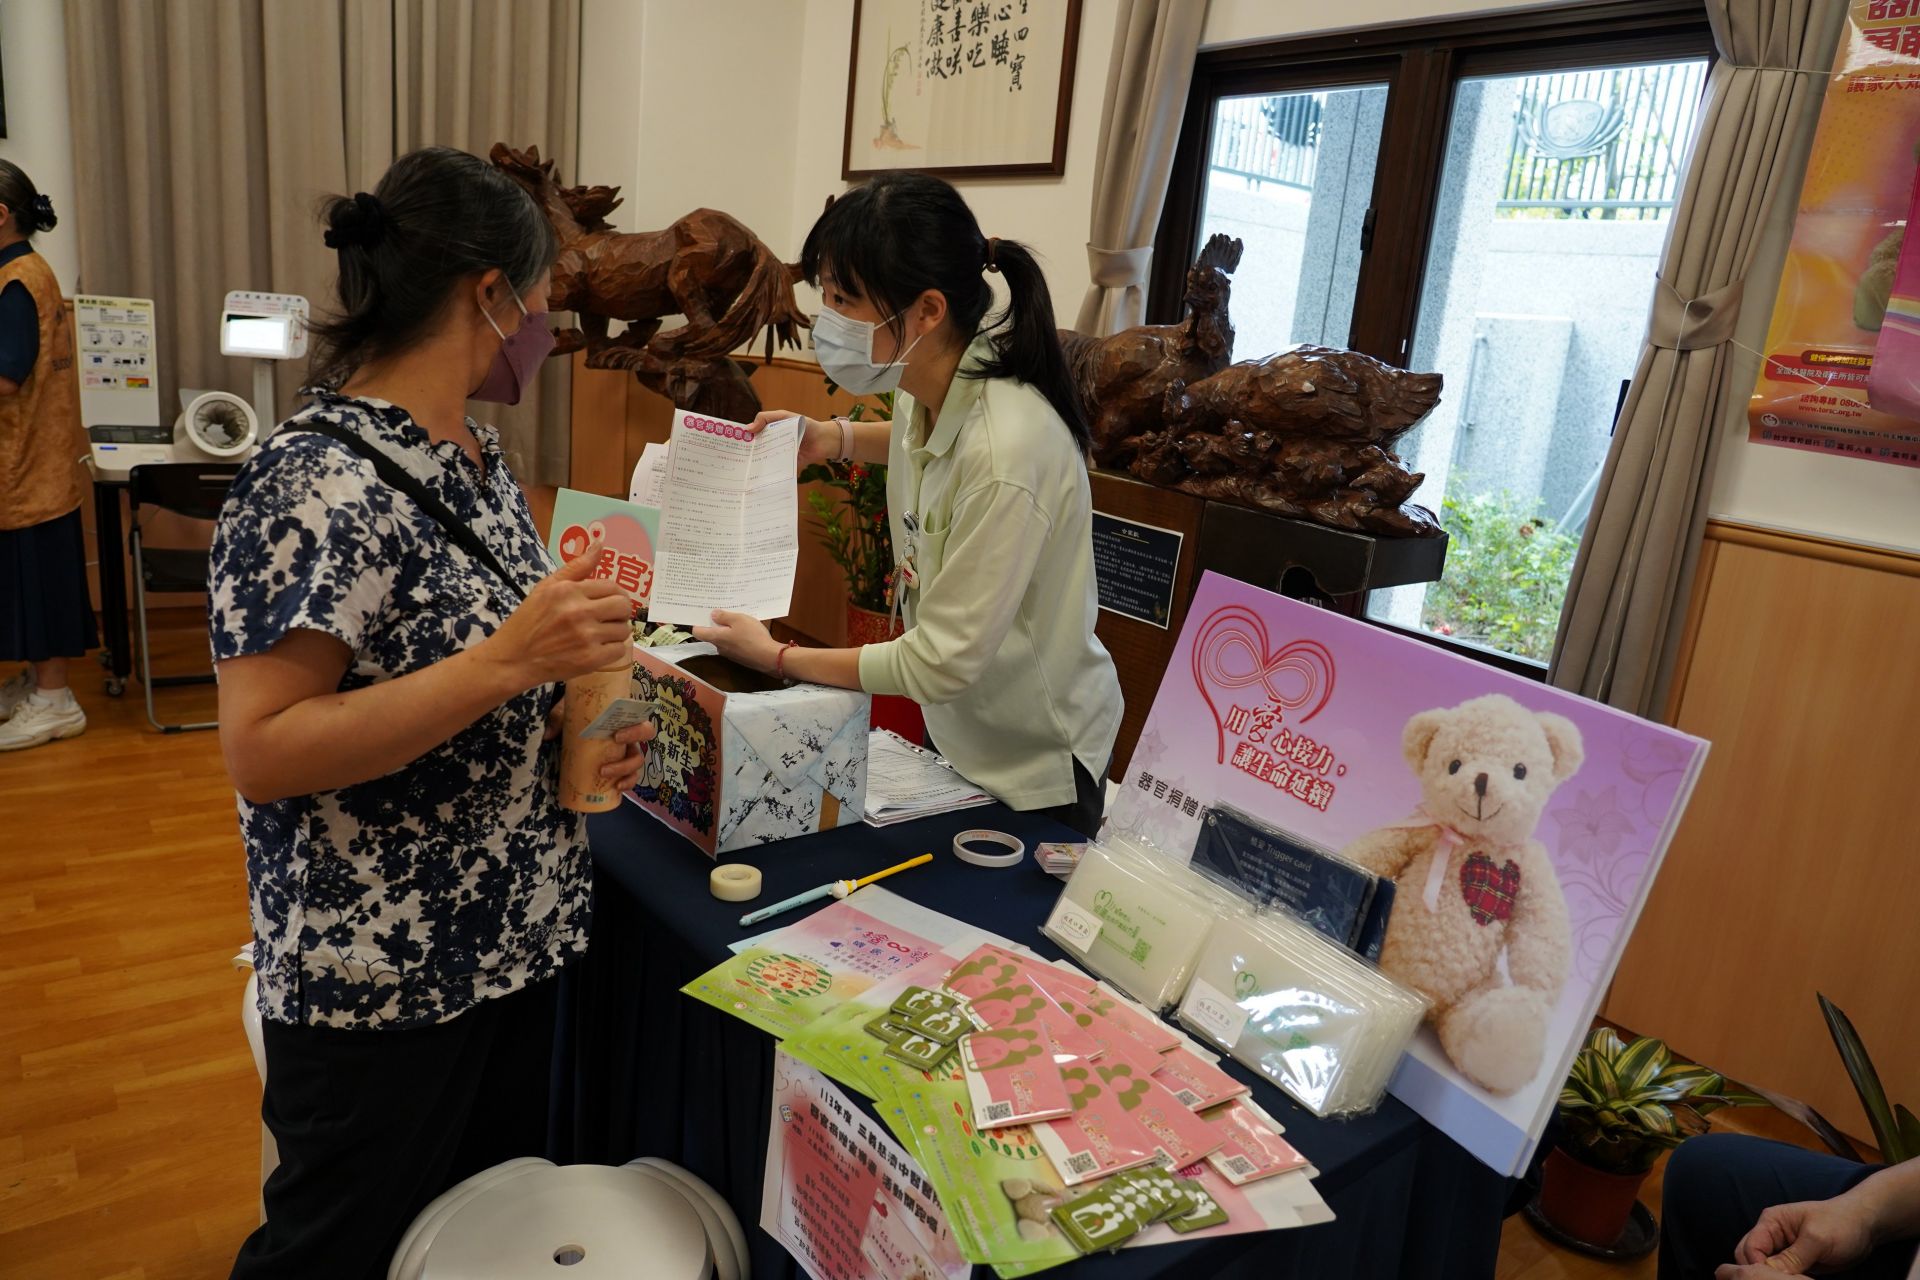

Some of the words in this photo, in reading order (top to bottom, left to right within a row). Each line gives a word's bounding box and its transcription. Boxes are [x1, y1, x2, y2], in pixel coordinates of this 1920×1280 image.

[667, 740, 692, 770] 新生
[1231, 742, 1336, 812] 讓生命延續
[1266, 840, 1294, 863] Trigger
[1294, 855, 1313, 872] card
